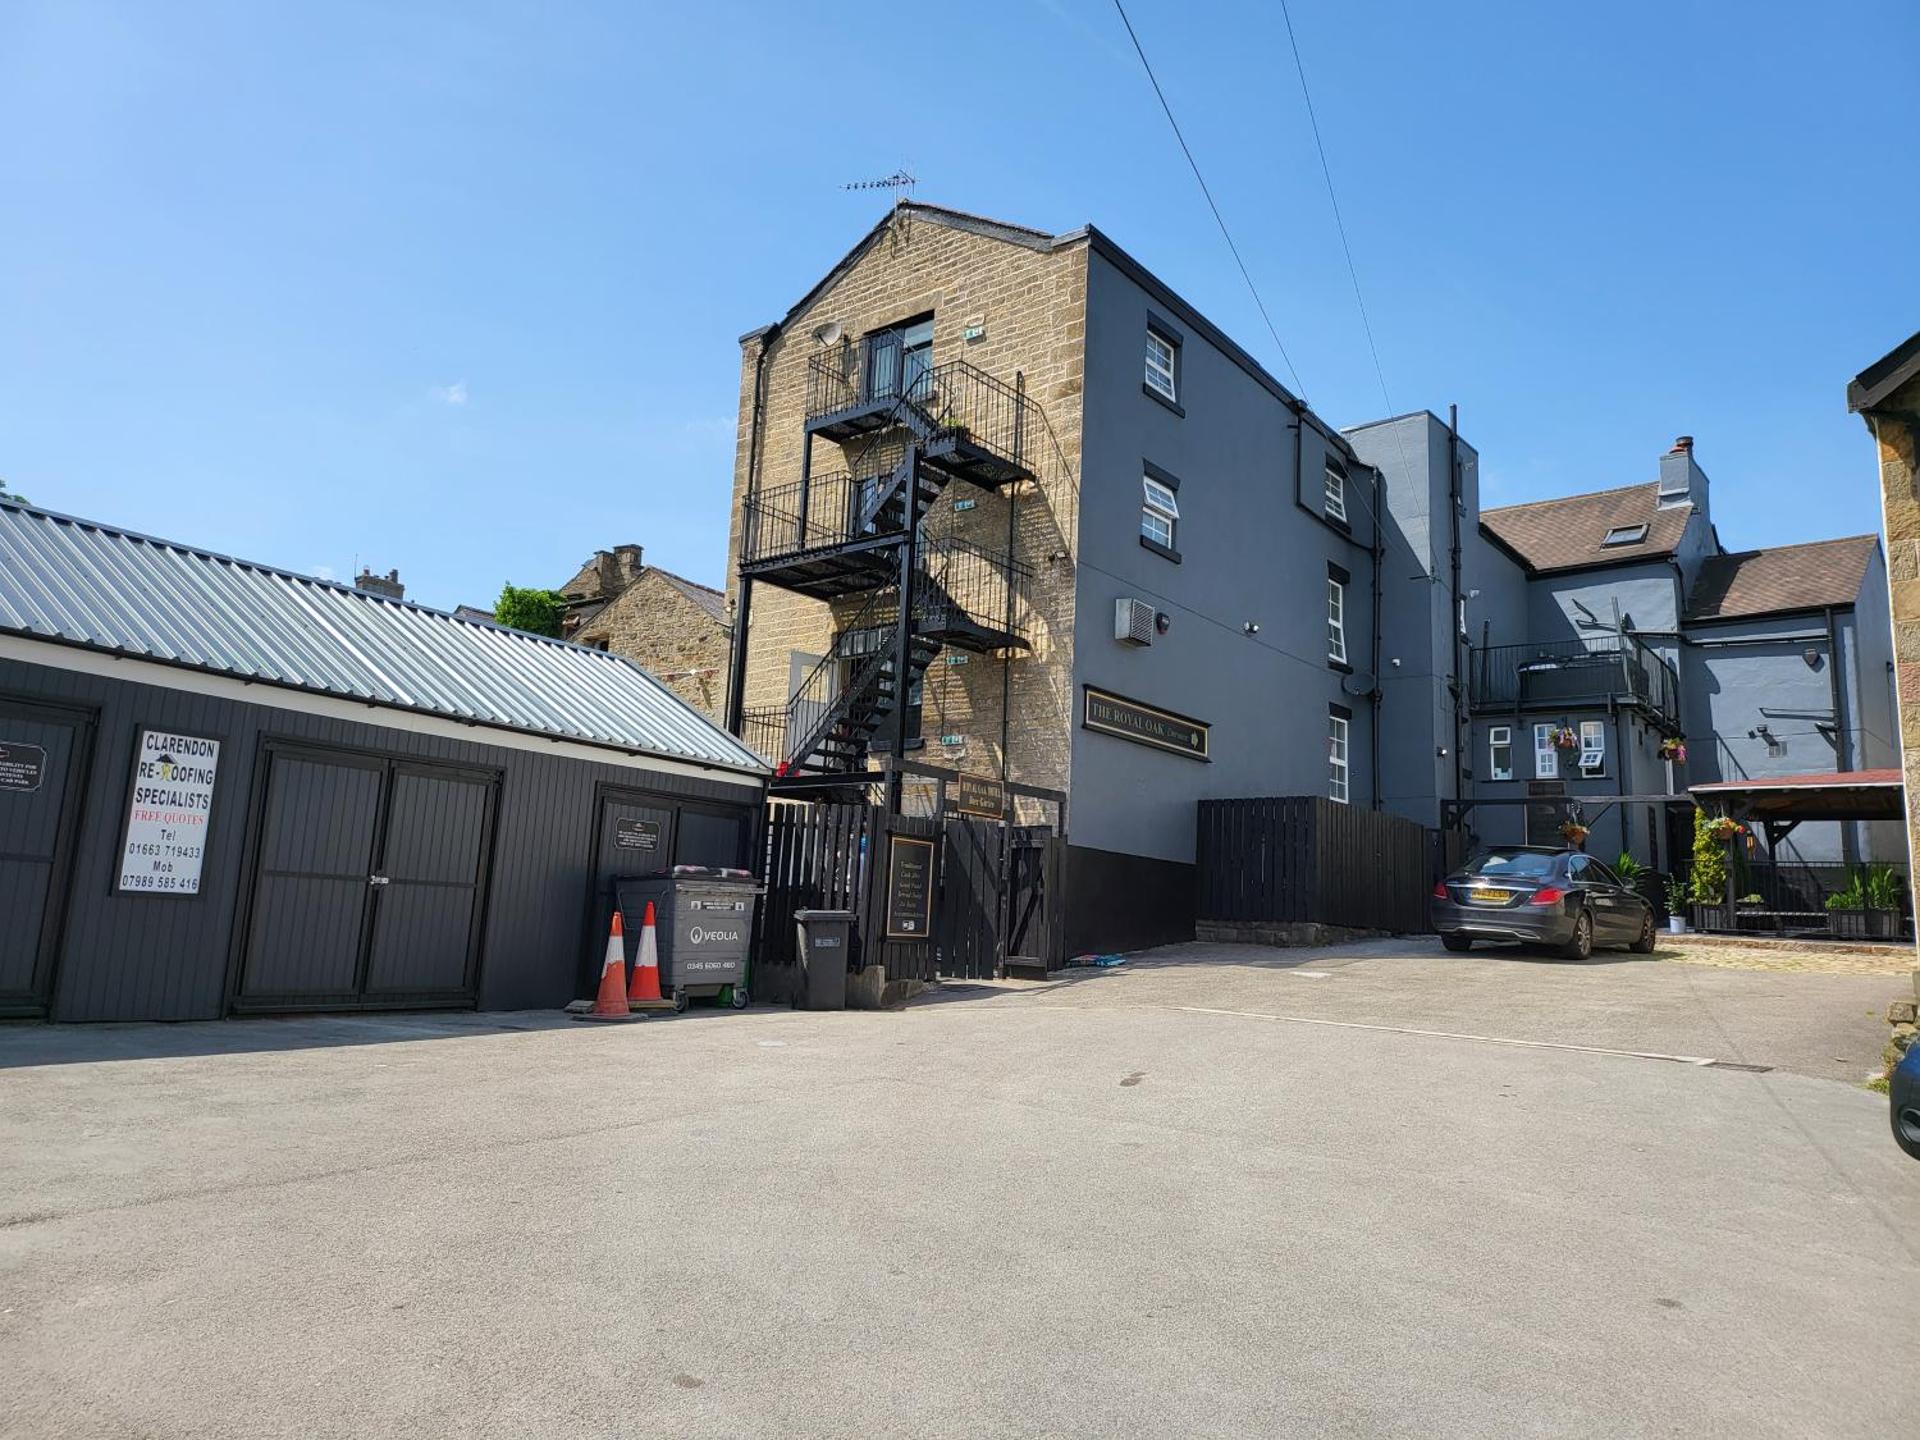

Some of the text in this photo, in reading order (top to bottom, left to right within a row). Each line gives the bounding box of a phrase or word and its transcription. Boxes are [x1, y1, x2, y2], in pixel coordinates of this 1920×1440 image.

[1093, 703, 1111, 719] THE
[1114, 709, 1143, 729] ROYAL
[1145, 719, 1165, 737] OAK
[146, 734, 215, 757] CLARENDON
[136, 787, 209, 809] SPECIALISTS
[135, 810, 204, 824] FREE QUOTES
[161, 829, 176, 841] Tel
[129, 843, 200, 858] 01663 719433
[153, 860, 174, 872] Mob
[122, 875, 198, 890] 07989 585 416
[704, 931, 738, 941] VEOLIA
